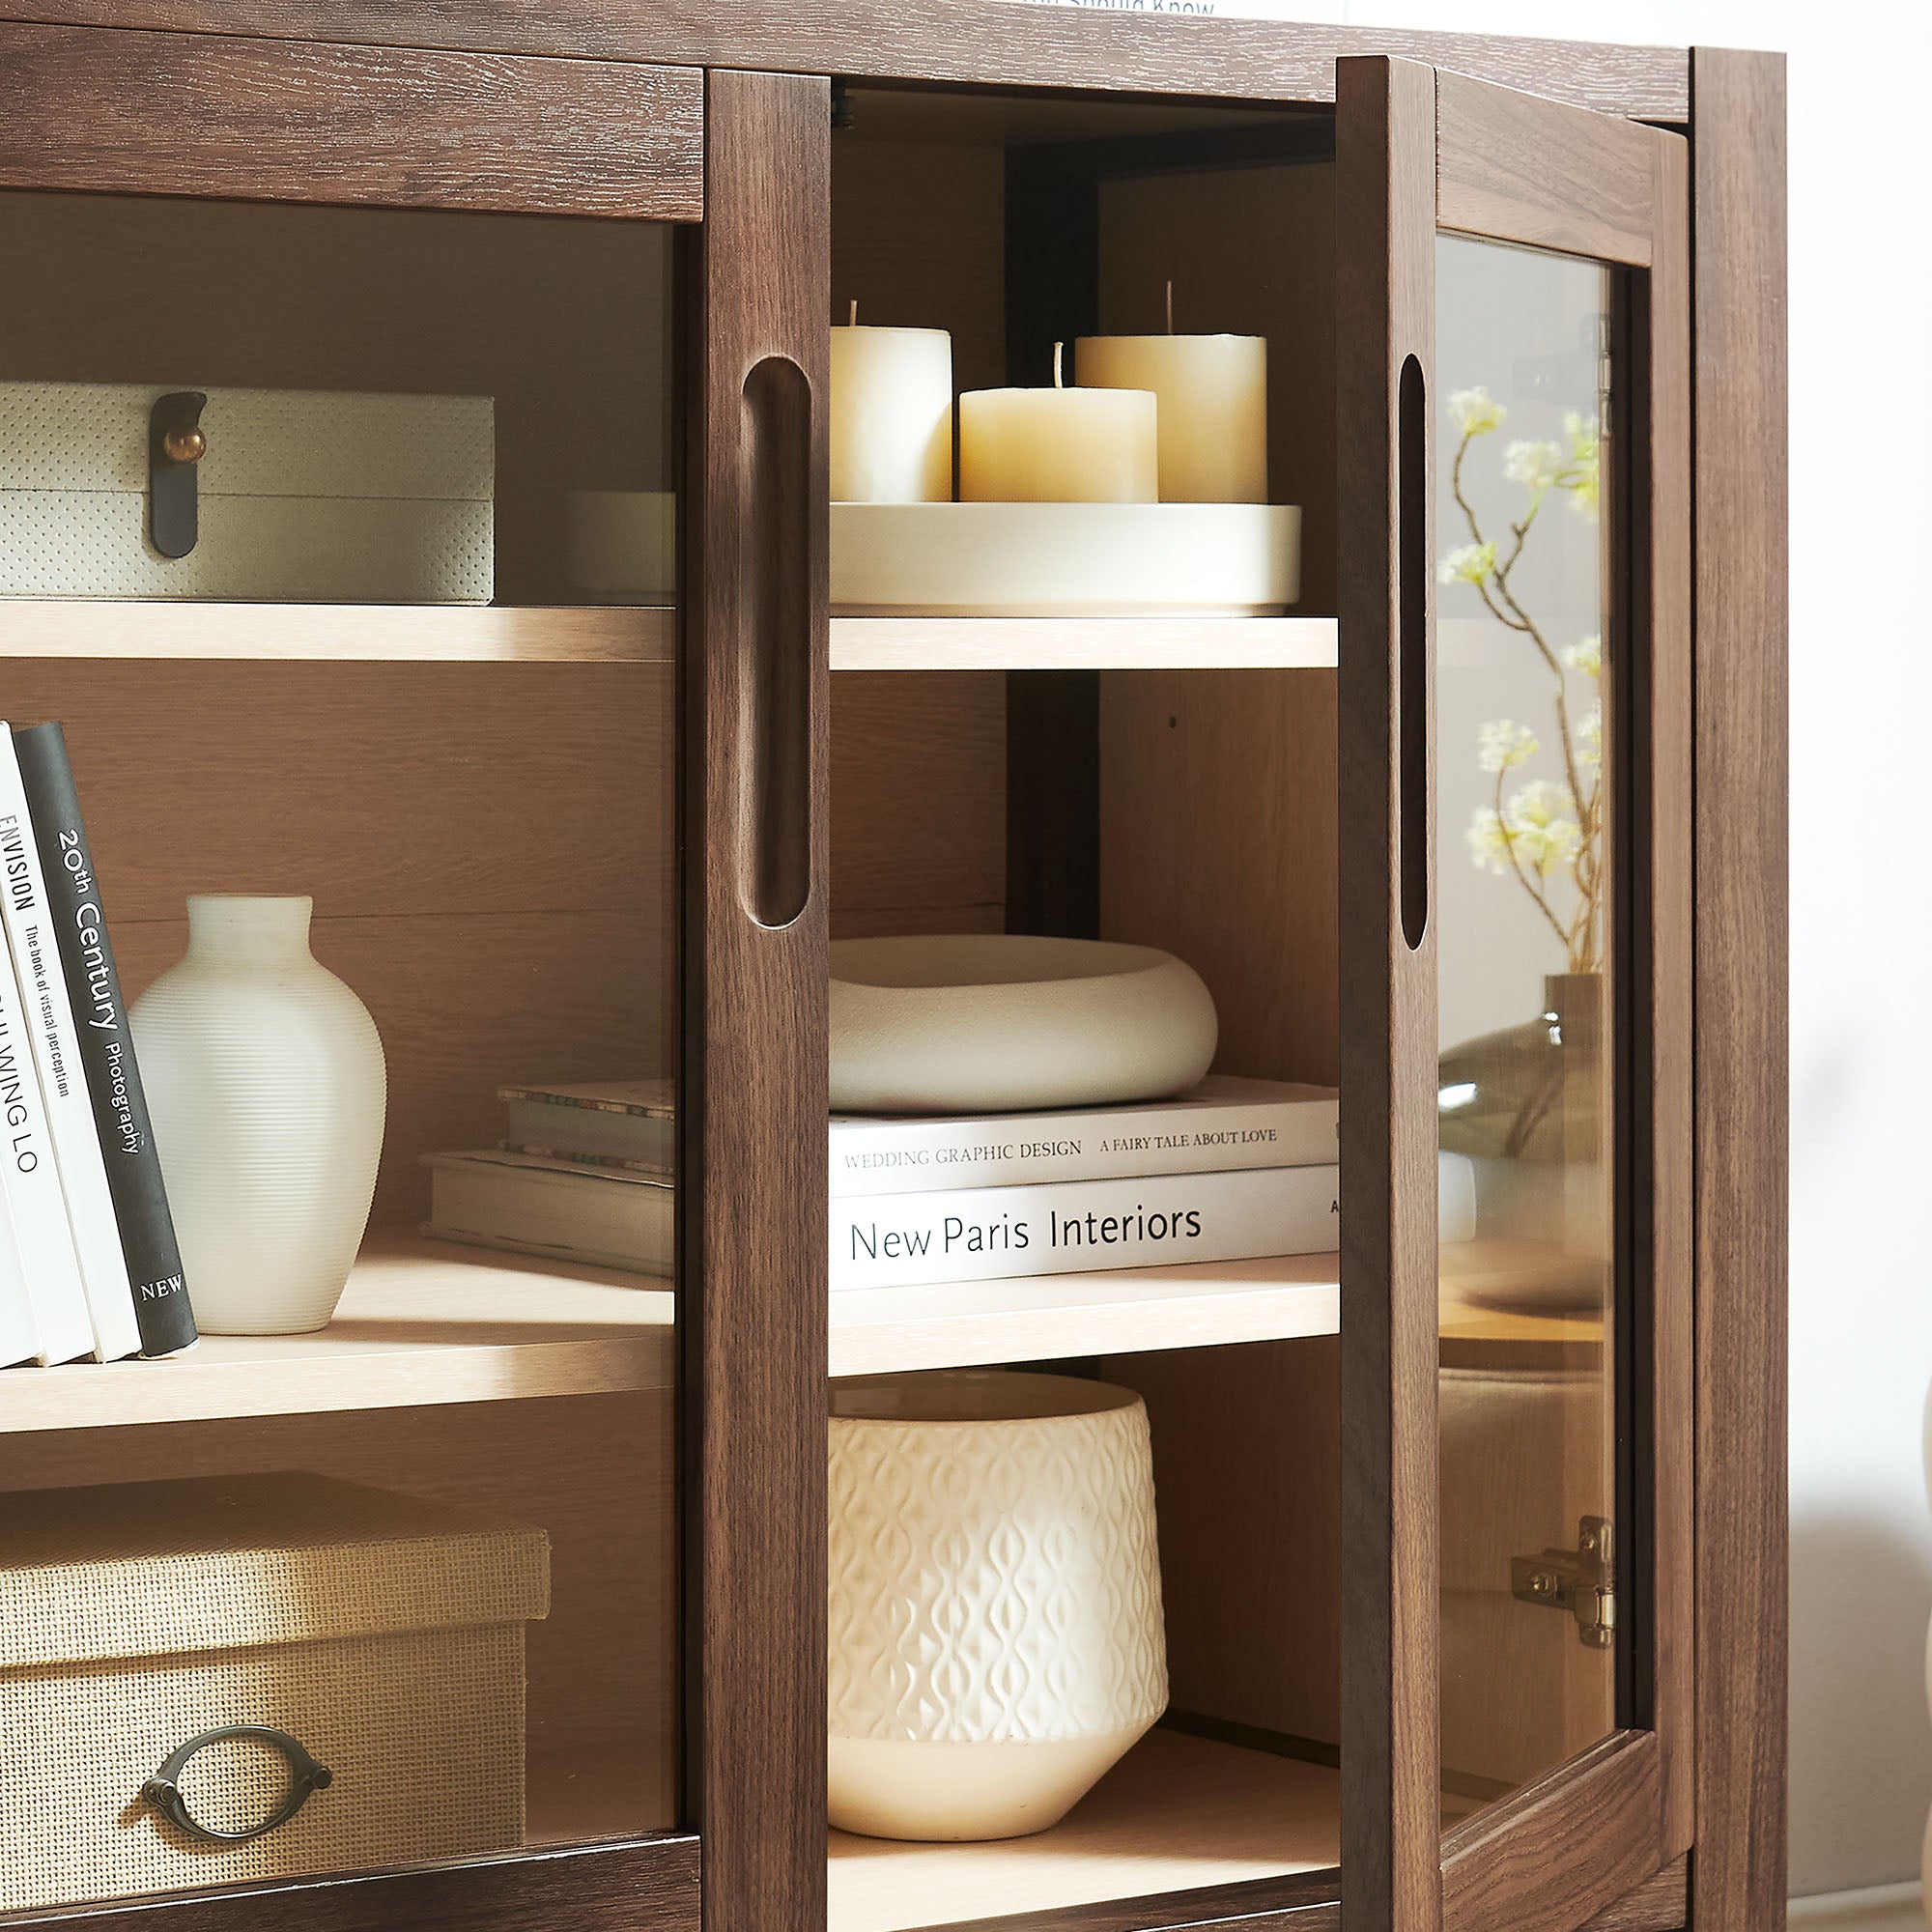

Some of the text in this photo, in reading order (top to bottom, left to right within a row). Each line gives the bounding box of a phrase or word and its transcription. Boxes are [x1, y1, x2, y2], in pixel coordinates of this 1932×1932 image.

[0, 814, 35, 911] ENVISION
[25, 923, 70, 1097] The book of visual perception
[58, 829, 141, 1154] 20th Century Photography
[13, 1133, 38, 1172] LO
[845, 1140, 1082, 1169] WEDDING GRAPHIC DESIGN
[1099, 1129, 1277, 1151] A FAIRY TALE ABOUT LOVE
[851, 1204, 1202, 1261] New Paris Interiors
[140, 1274, 183, 1300] NEW
